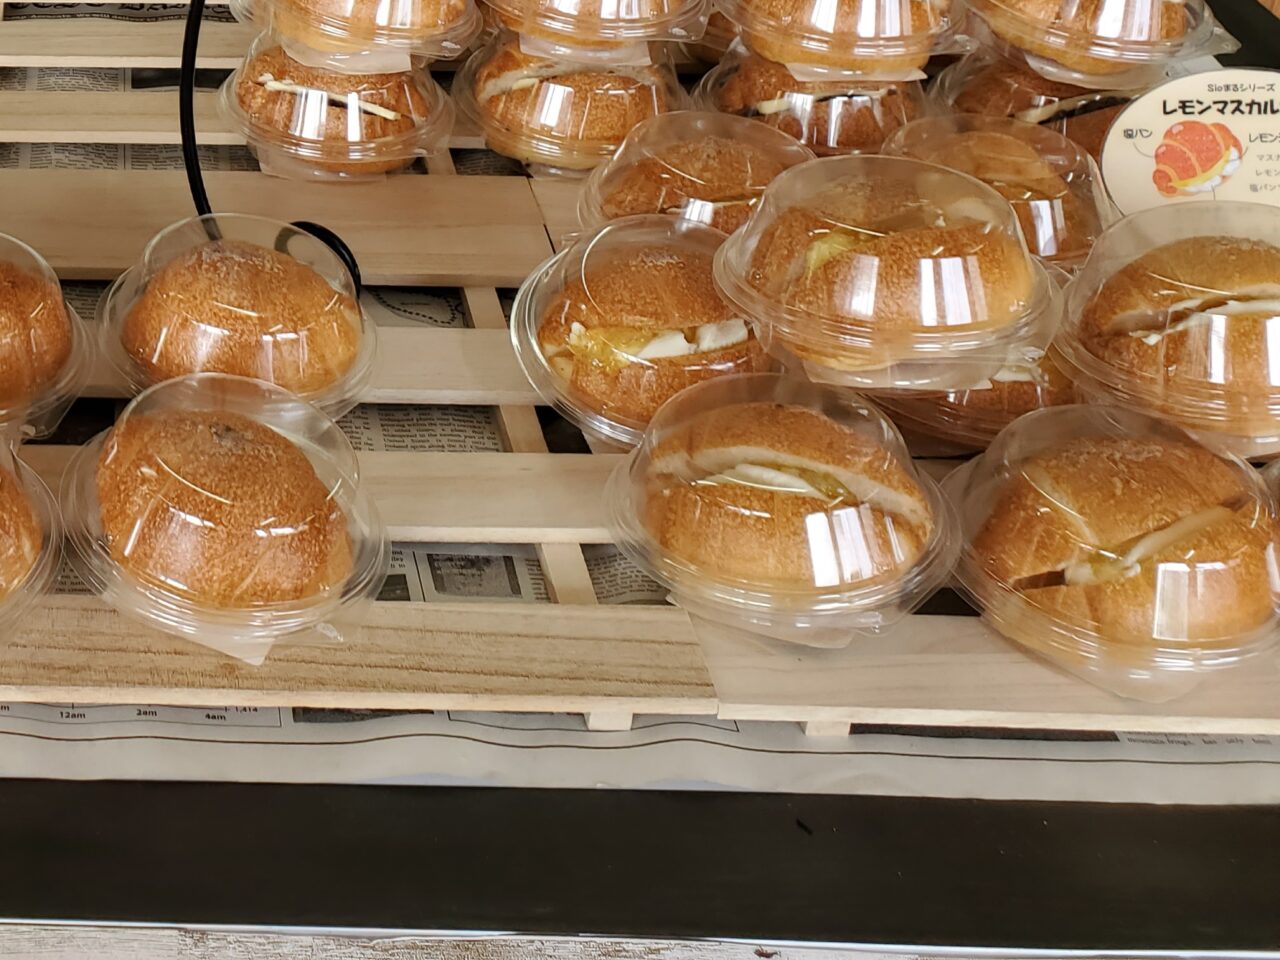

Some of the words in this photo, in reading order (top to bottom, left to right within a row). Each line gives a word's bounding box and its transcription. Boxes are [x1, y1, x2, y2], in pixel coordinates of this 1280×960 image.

[1162, 99, 1280, 115] レモンマスカル
[59, 711, 86, 720] 12am
[136, 708, 158, 717] 2am
[205, 713, 227, 721] 4am
